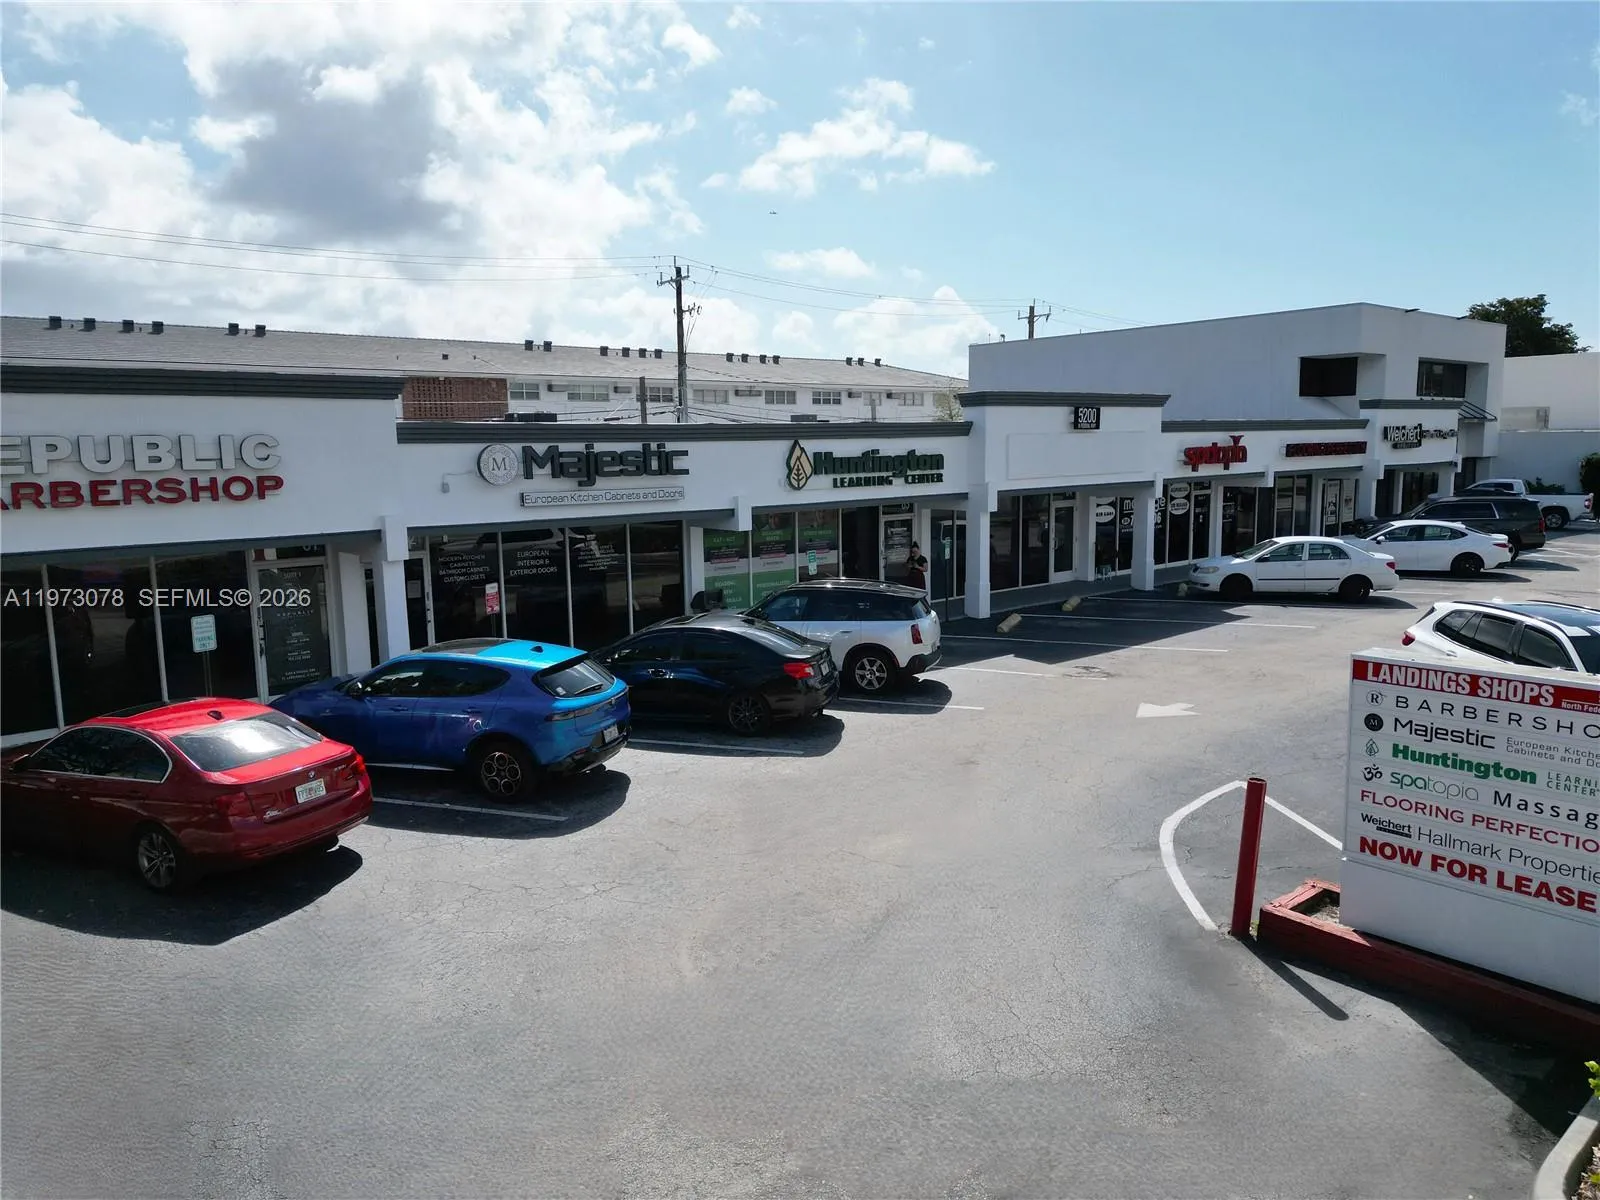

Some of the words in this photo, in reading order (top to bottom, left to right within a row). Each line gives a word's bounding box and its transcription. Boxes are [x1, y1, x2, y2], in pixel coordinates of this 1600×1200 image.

[1078, 408, 1097, 423] 5200
[1385, 423, 1422, 441] Weichert
[521, 442, 690, 488] Majestic
[813, 448, 945, 478] Huntington
[0, 475, 284, 511] RBERSHOP
[524, 494, 568, 505] European
[570, 492, 604, 503] Kitchen
[604, 491, 641, 501] Cabinets
[641, 490, 658, 499] and
[658, 489, 683, 499] Doors
[833, 475, 894, 488] LEARNING
[904, 473, 944, 485] CENTER
[1367, 662, 1471, 695] LANDINGS
[1477, 677, 1555, 706] SHOPS
[1395, 695, 1600, 739] BARBERSHO
[1561, 701, 1582, 711] North
[1393, 717, 1496, 750] Majestic
[1506, 737, 1560, 753] European
[1391, 743, 1537, 785] Huntington
[1506, 745, 1555, 760] Cabinets
[1560, 754, 1581, 765] and
[1389, 771, 1480, 801] spatopia
[1493, 790, 1600, 830] Massag
[1546, 781, 1596, 797] CENTER
[1360, 789, 1465, 823] FLOORING
[1471, 813, 1600, 853] PERFECTIO
[1361, 812, 1412, 834] Weichert
[1418, 826, 1502, 861] Hallmark
[1508, 847, 1600, 885] Propertie
[1360, 836, 1423, 868] NOW
[1430, 854, 1488, 886] FOR
[1496, 870, 1598, 914] LEASE
